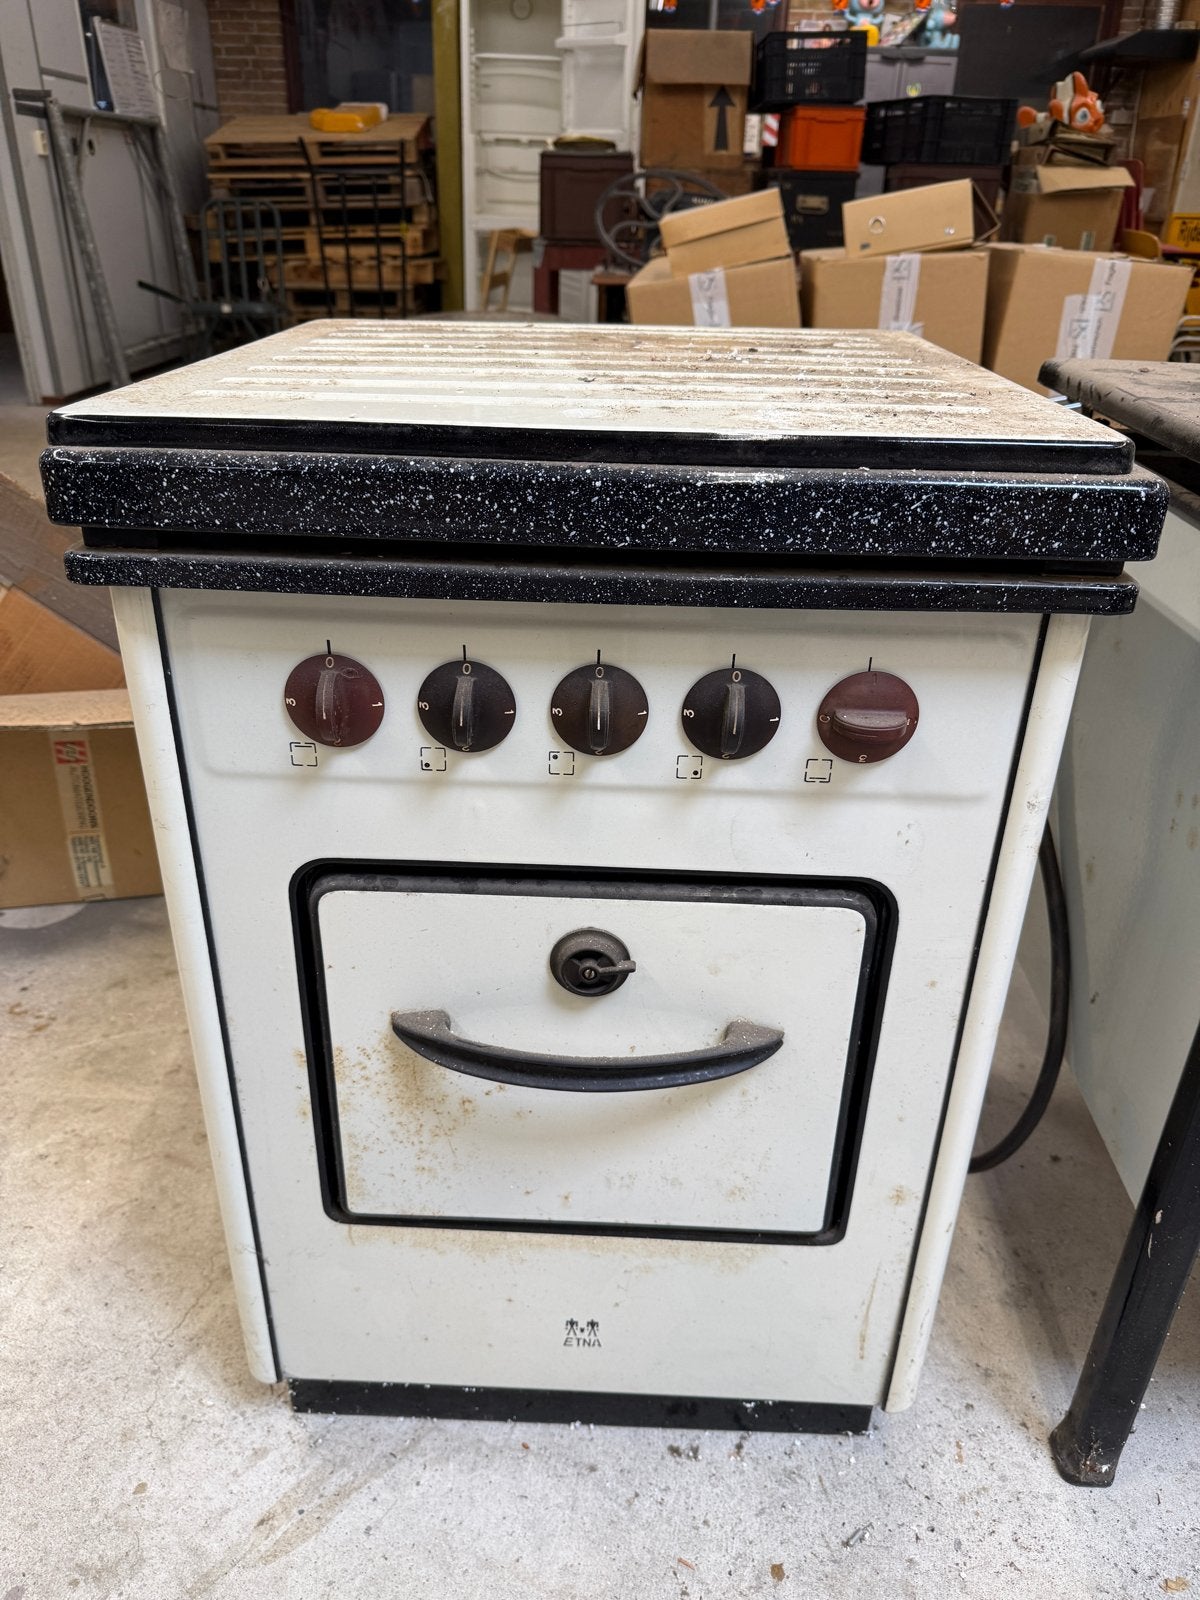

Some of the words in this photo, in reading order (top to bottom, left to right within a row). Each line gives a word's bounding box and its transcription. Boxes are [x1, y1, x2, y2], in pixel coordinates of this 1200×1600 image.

[325, 656, 335, 668] 0
[462, 663, 472, 675] 0
[595, 667, 604, 678] 0
[732, 670, 742, 682] 0
[285, 697, 297, 707] 3
[418, 701, 429, 711] 3
[551, 706, 563, 717] 3
[683, 708, 695, 719] 3
[563, 1337, 602, 1347] ETNA
